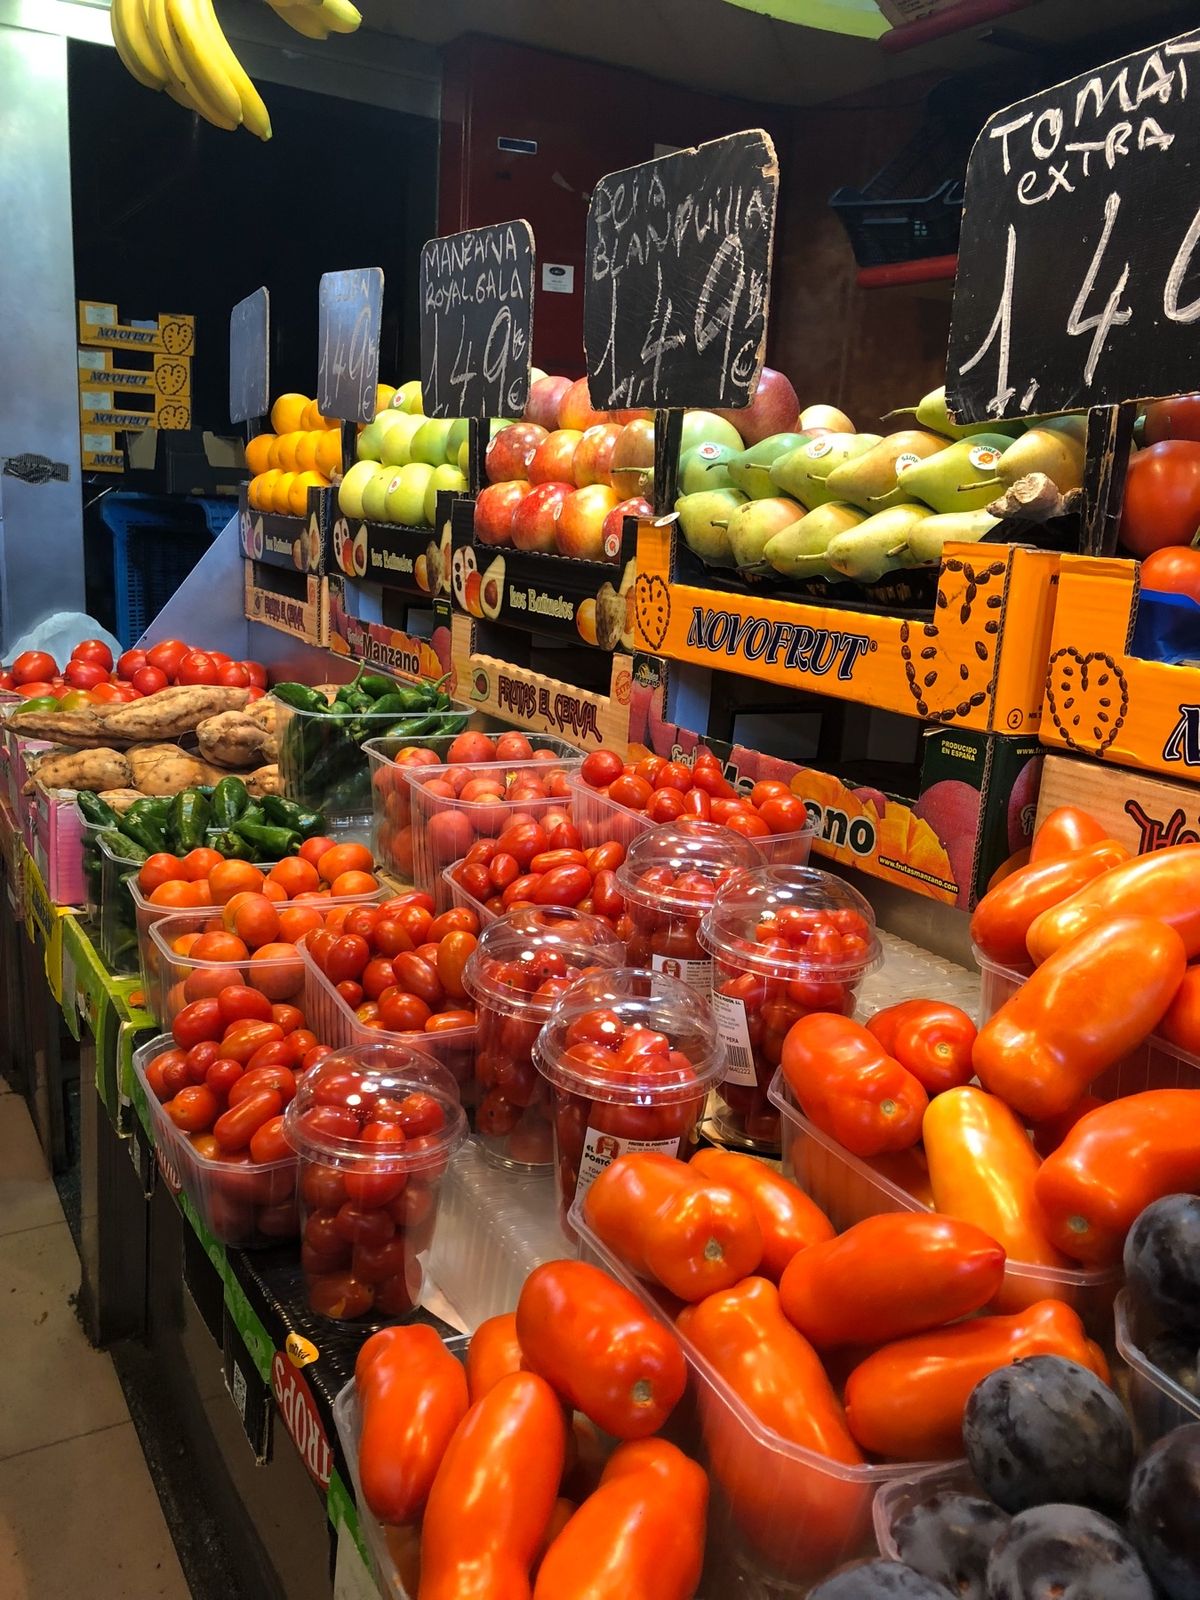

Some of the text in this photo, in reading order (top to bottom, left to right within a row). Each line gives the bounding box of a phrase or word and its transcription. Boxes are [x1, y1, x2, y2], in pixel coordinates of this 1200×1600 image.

[362, 631, 420, 675] Manzano
[498, 675, 537, 719] FRUTAS
[539, 688, 556, 726] EL
[1012, 714, 1019, 723] 2
[941, 739, 978, 755] PRODUCIDO
[941, 746, 976, 762] EN ESPAÑA
[878, 856, 959, 893] www.frutasmanzano.com
[584, 1152, 611, 1168] PORTÓ
[275, 1356, 330, 1484] TROPS
